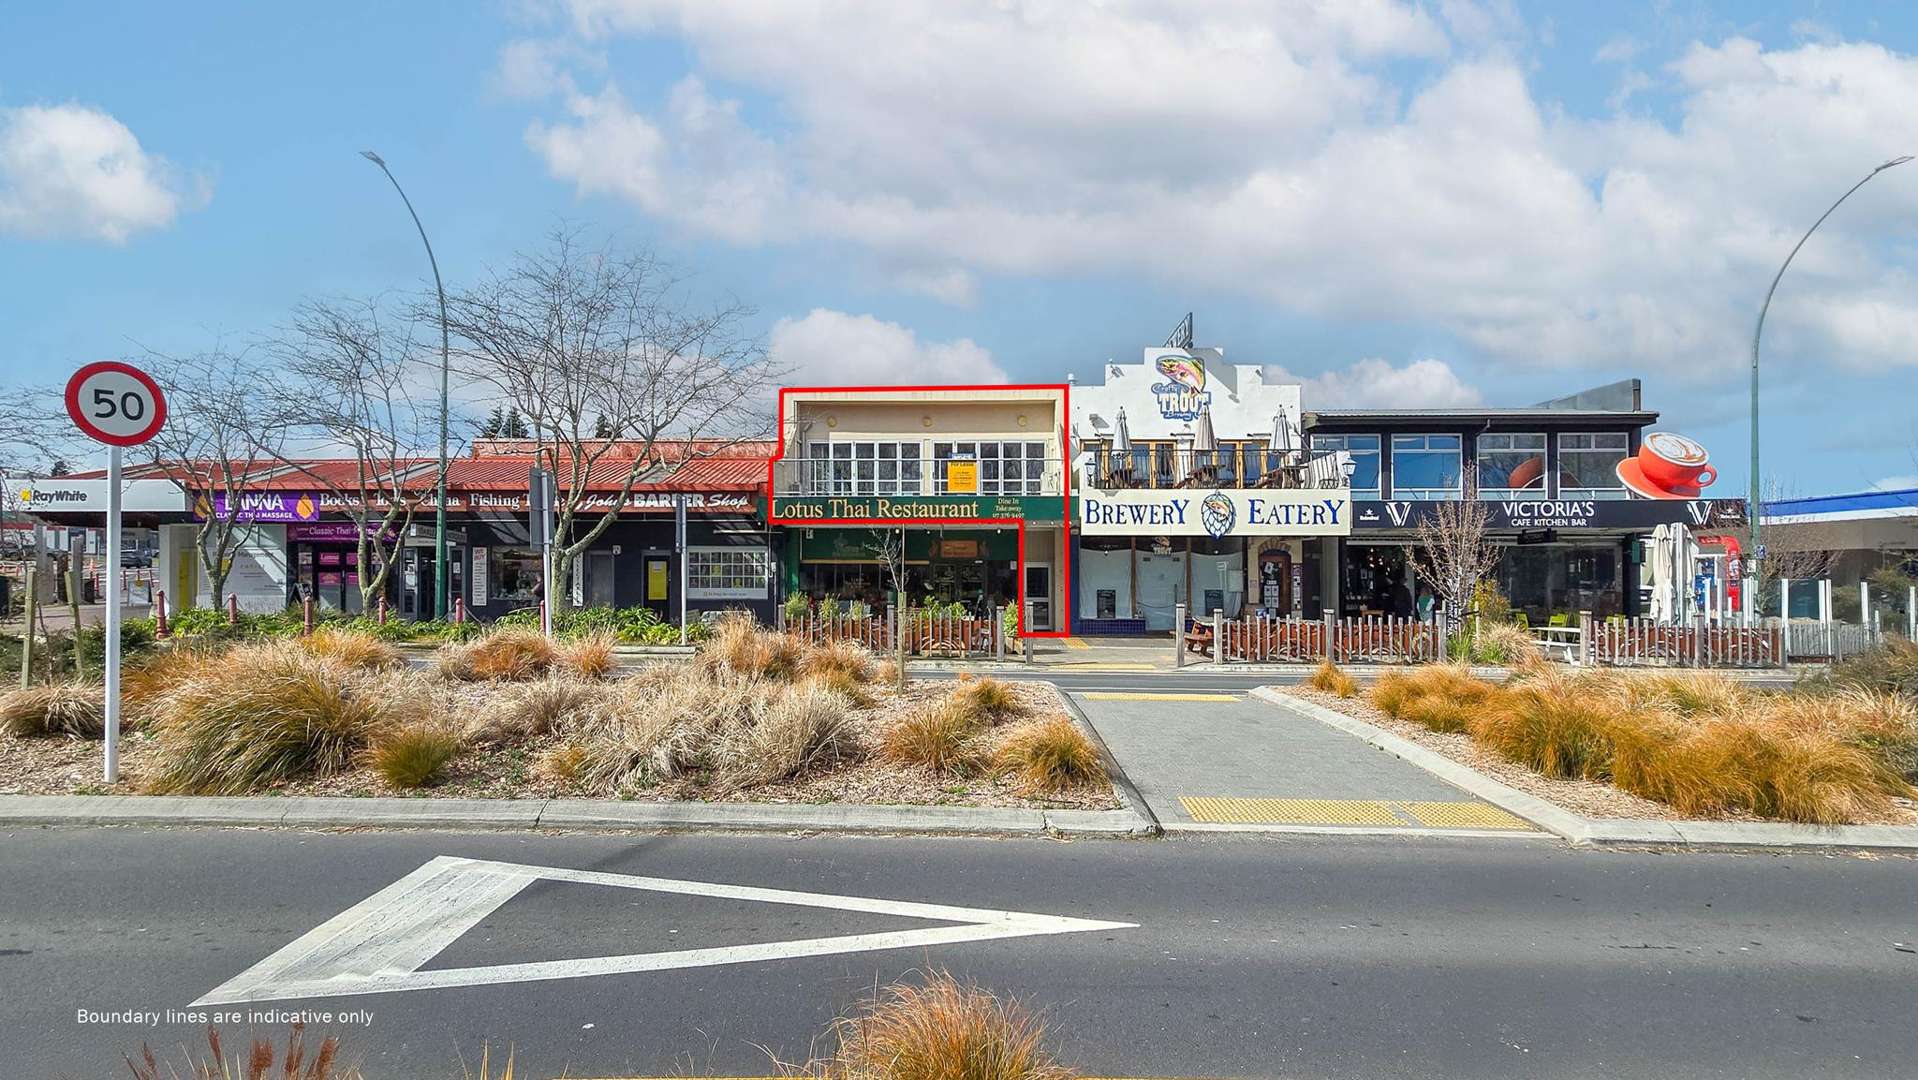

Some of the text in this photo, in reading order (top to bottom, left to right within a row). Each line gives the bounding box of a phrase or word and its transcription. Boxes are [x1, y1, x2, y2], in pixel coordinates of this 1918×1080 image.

[94, 388, 144, 421] 50
[1158, 392, 1209, 413] TROUT
[470, 493, 520, 509] Fishing
[634, 493, 704, 507] BARER
[708, 493, 748, 509] Shop
[772, 499, 980, 518] Lotus Thai Restaurant
[261, 511, 293, 519] MASSAGE
[1084, 499, 1345, 525] BREWERY EATERY
[1502, 502, 1595, 517] VICTORIA'S
[1511, 518, 1587, 526] CAFE KITCHEN BAR
[309, 526, 334, 535] Classic
